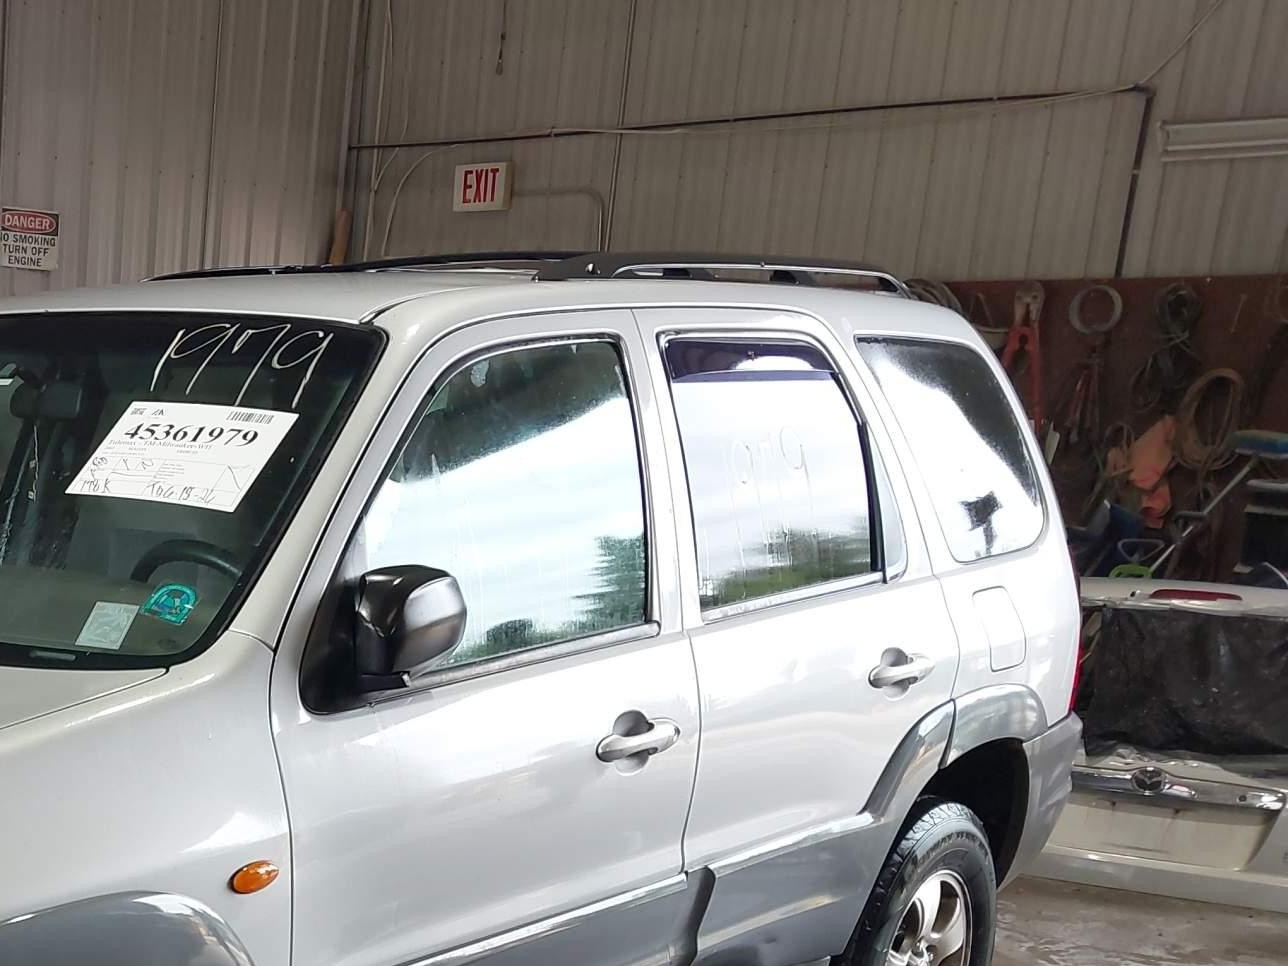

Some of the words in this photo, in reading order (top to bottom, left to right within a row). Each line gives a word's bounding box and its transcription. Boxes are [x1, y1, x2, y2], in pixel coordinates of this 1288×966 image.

[462, 167, 500, 204] EXIT
[4, 214, 50, 230] DANGER
[13, 233, 56, 247] SMOKING
[2, 243, 28, 254] TURN
[31, 246, 49, 257] OFF
[7, 255, 42, 267] ENGINE
[150, 322, 334, 409] 1979
[124, 422, 259, 447] 45361979
